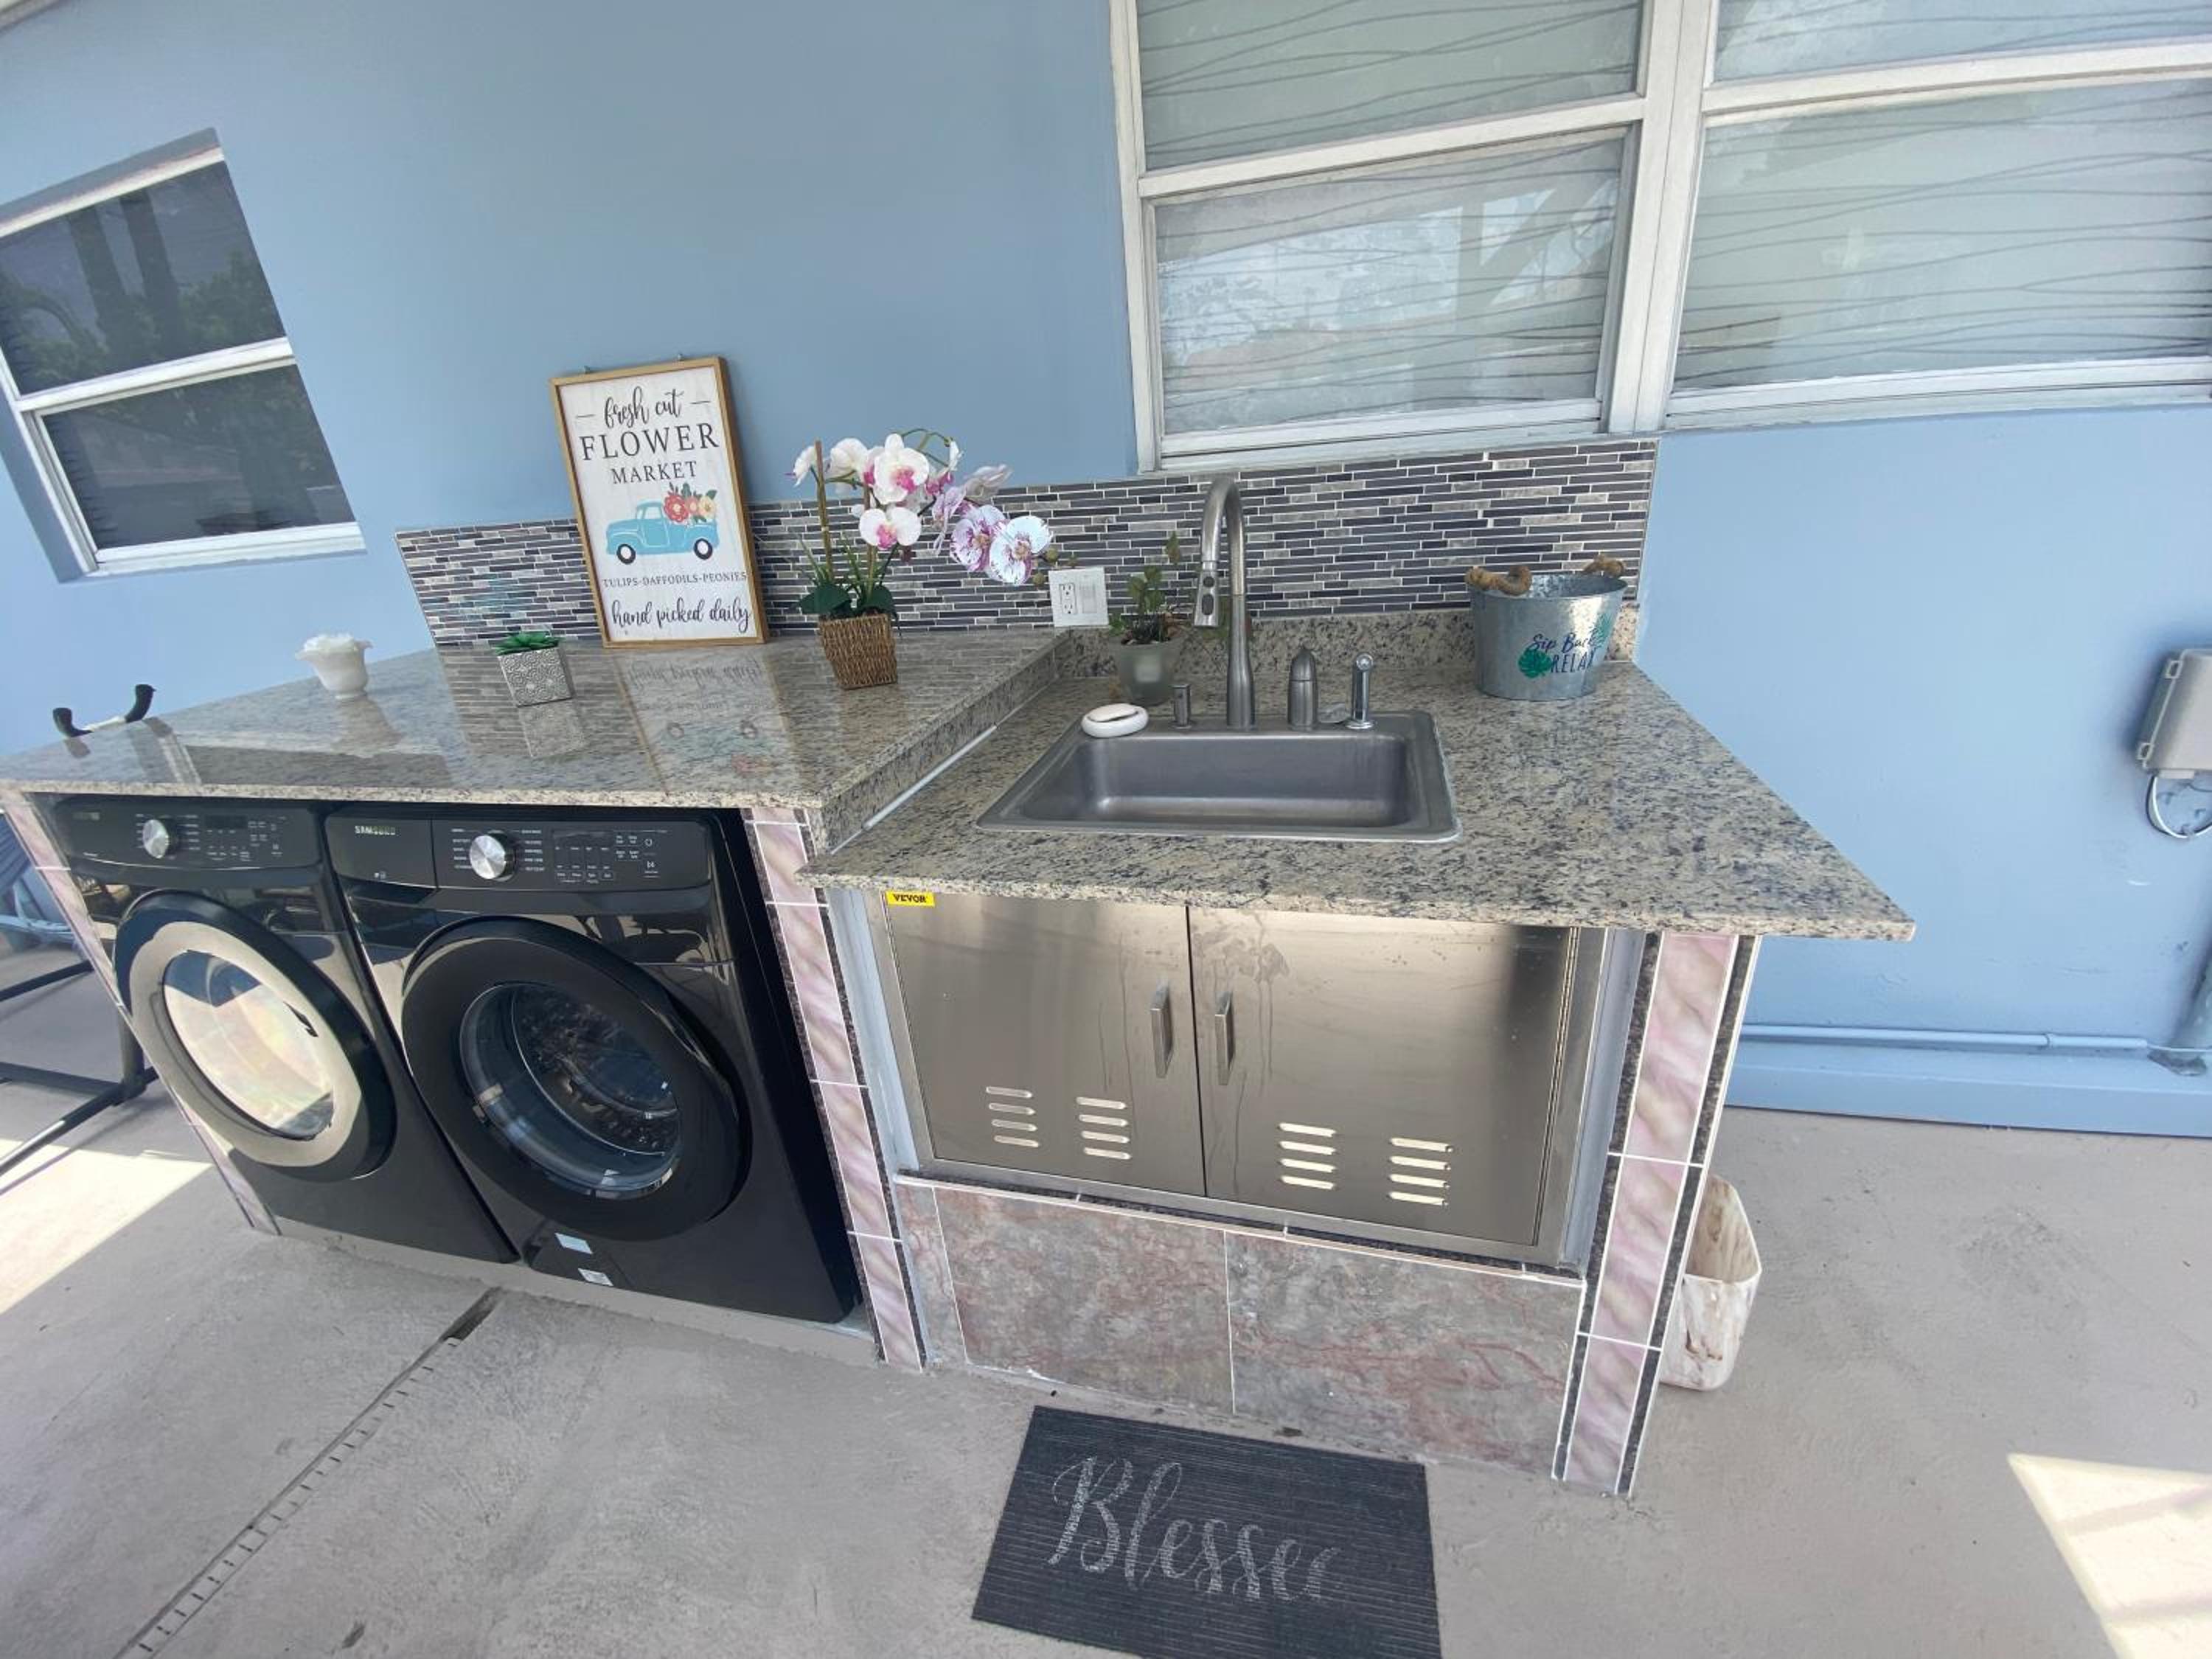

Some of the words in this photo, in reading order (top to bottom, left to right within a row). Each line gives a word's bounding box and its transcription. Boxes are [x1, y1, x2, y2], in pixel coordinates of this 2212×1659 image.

[604, 386, 650, 429] fresh
[655, 389, 685, 418] cut
[579, 422, 720, 461] FLOWER
[611, 461, 697, 484] MARKET
[611, 599, 653, 627] hand
[655, 597, 705, 629] picked
[709, 596, 751, 633] daily
[893, 894, 927, 903] VEVOR
